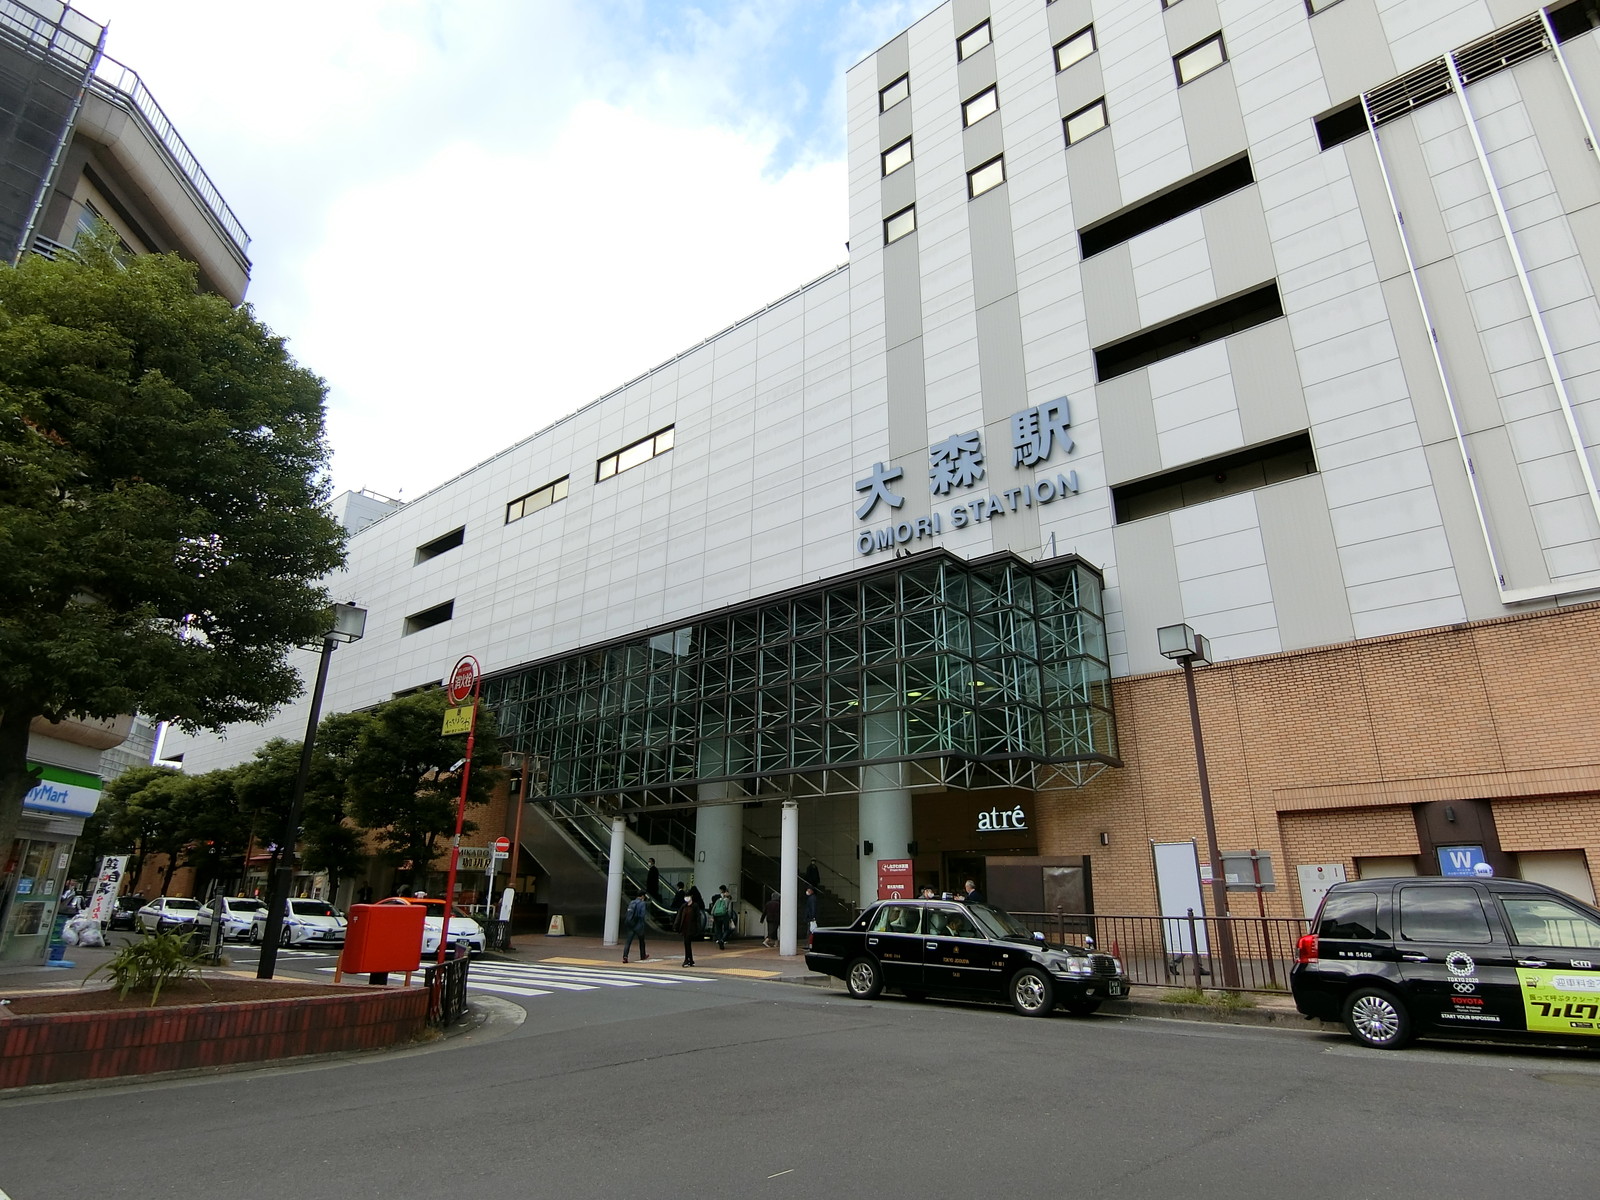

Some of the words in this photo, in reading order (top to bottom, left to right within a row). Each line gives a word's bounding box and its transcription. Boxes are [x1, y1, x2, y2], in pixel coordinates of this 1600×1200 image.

[855, 396, 1075, 520] 大森駅
[857, 512, 941, 555] ŌMORI
[951, 470, 1079, 528] STATION
[454, 672, 473, 690] 消火栓
[977, 805, 1026, 829] atré
[1449, 851, 1471, 869] W
[1570, 959, 1592, 968] km
[1451, 997, 1484, 1005] TOYOTA
[1530, 1001, 1600, 1019] フルク
